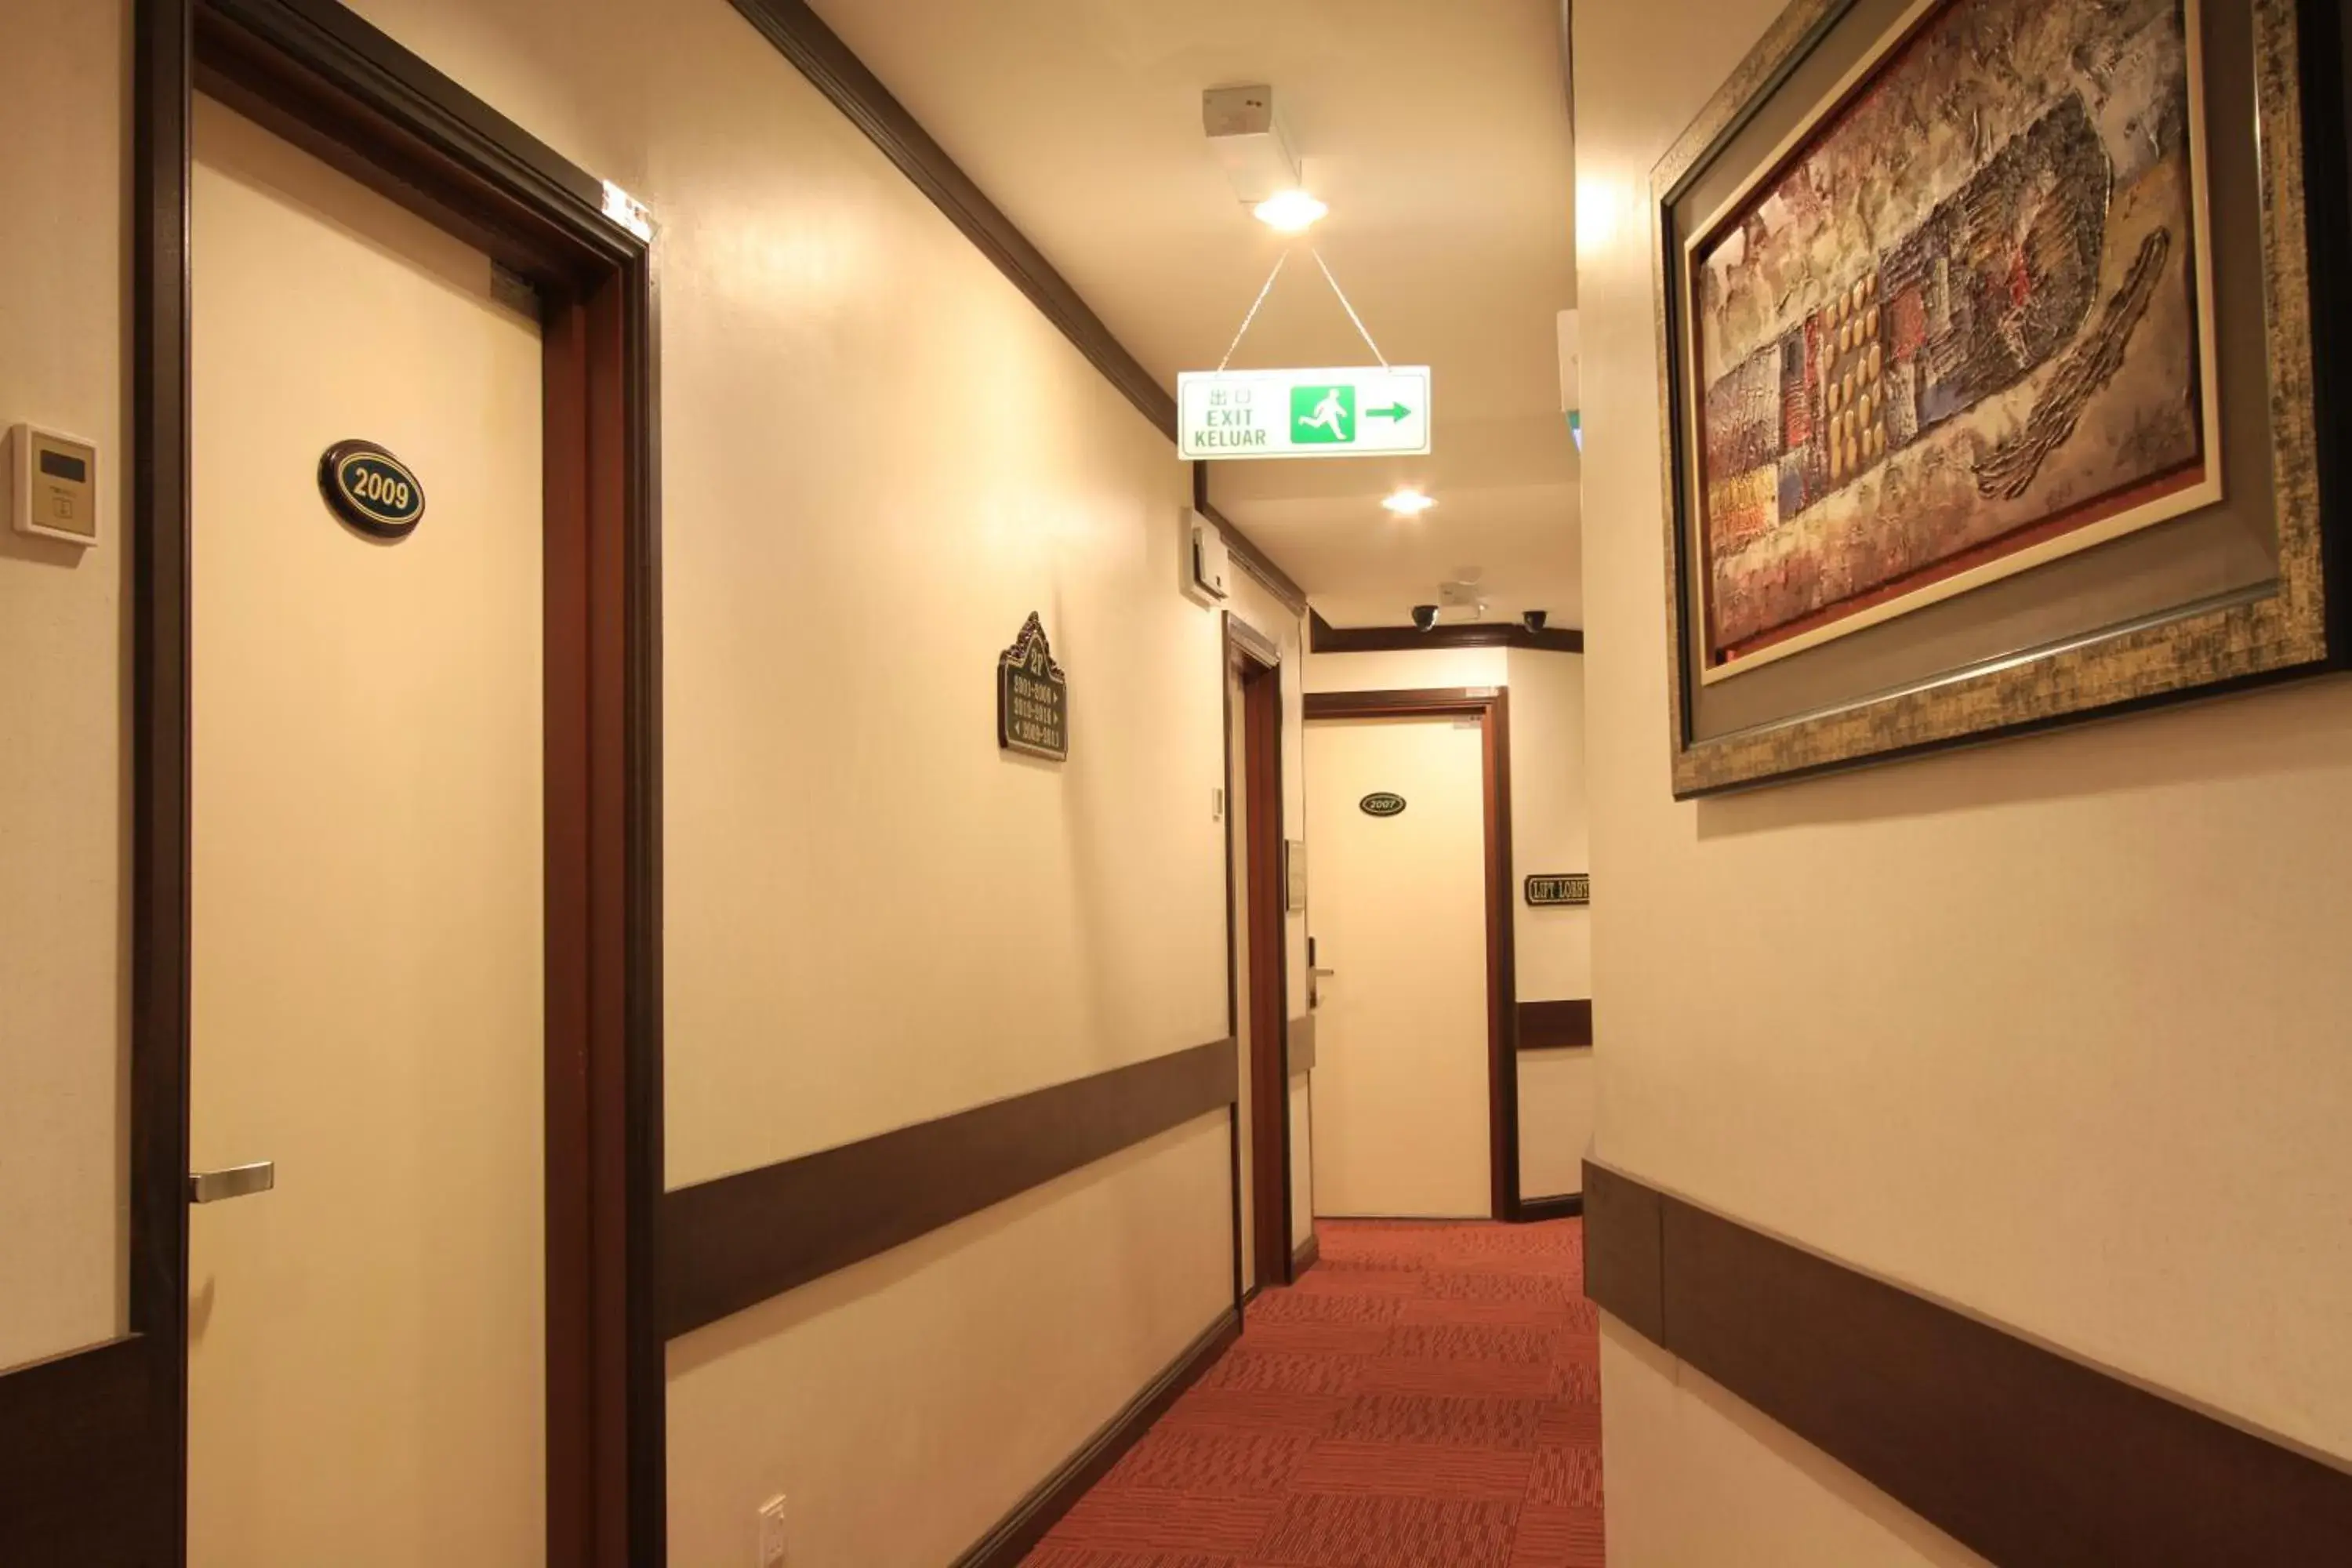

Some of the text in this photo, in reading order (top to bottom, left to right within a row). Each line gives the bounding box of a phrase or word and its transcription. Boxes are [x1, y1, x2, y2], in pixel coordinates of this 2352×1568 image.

[1207, 408, 1254, 426] EXIT
[1195, 429, 1266, 448] KELUAR
[354, 466, 408, 510] 2009
[1534, 882, 1555, 898] LIFT
